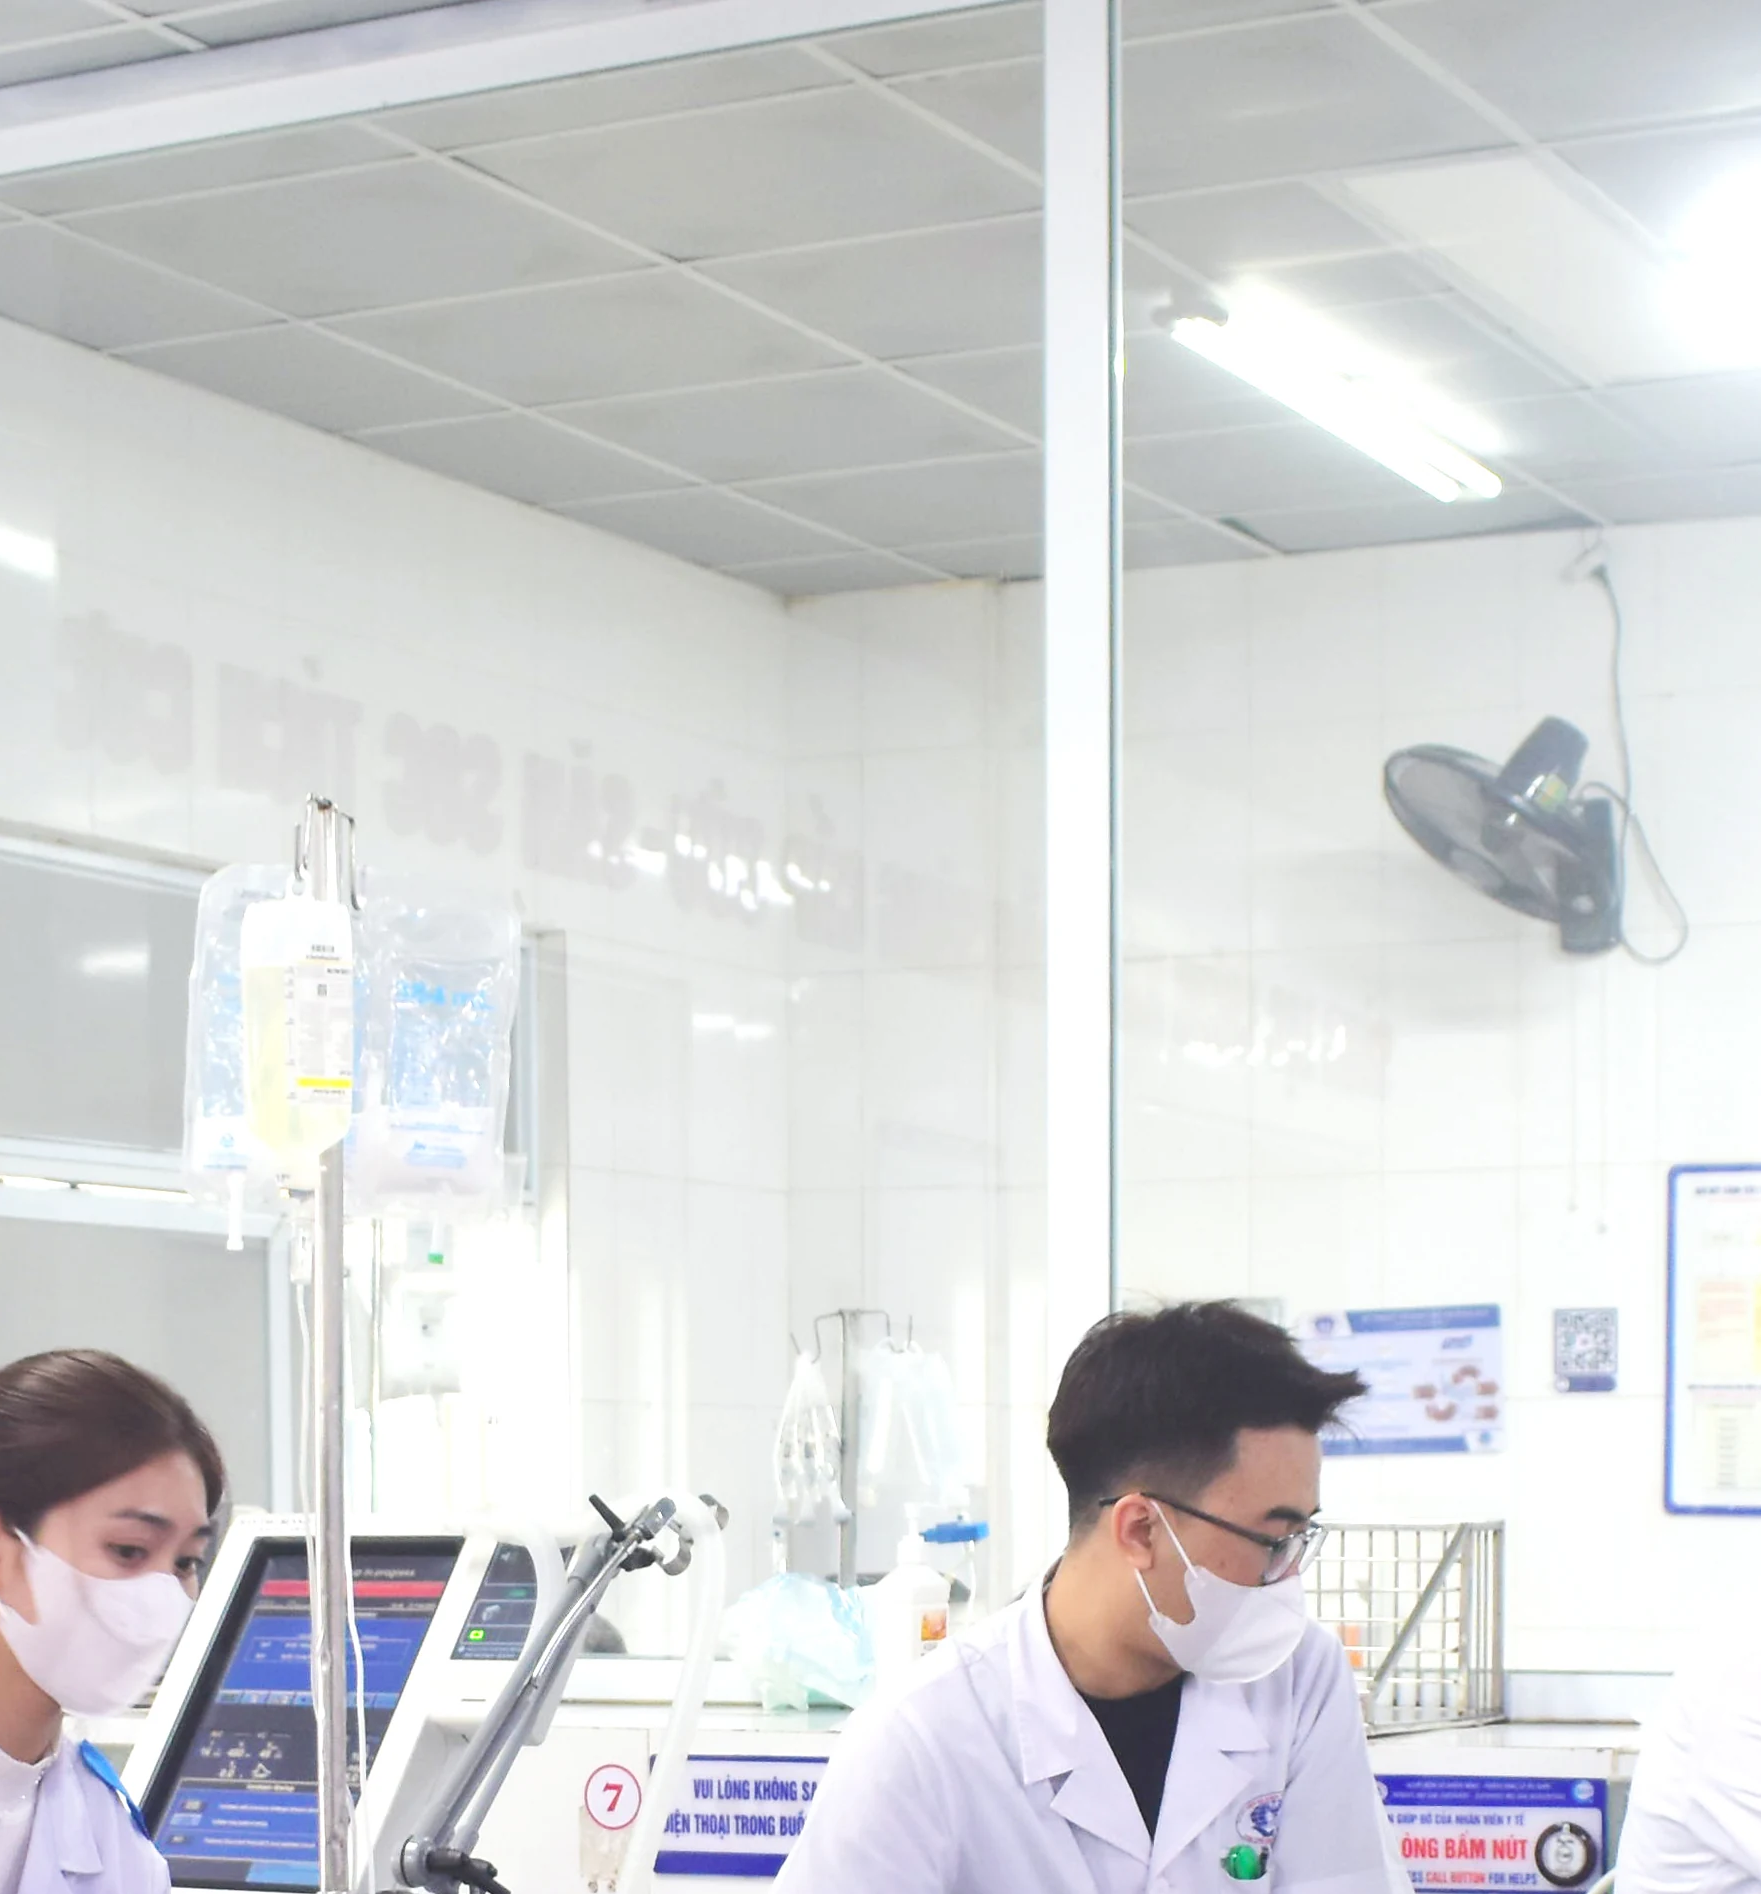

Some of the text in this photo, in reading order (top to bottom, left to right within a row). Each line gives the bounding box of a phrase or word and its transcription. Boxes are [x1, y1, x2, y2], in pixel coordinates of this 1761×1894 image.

[603, 1783, 623, 1812] 7
[693, 1778, 713, 1799] VUI
[754, 1776, 797, 1801] KHÔNG
[694, 1814, 730, 1840] THOẠI
[734, 1815, 775, 1836] TRONG
[1455, 1812, 1480, 1825] NHÂN
[1483, 1813, 1504, 1825] VIÊN
[1506, 1815, 1511, 1825] Y
[1445, 1829, 1486, 1859] BẤM
[1493, 1834, 1527, 1860] NÚT
[1426, 1871, 1447, 1883] CALL
[1451, 1871, 1485, 1884] BUTTON
[1488, 1872, 1504, 1884] FOR
[1509, 1872, 1538, 1884] HELPS
